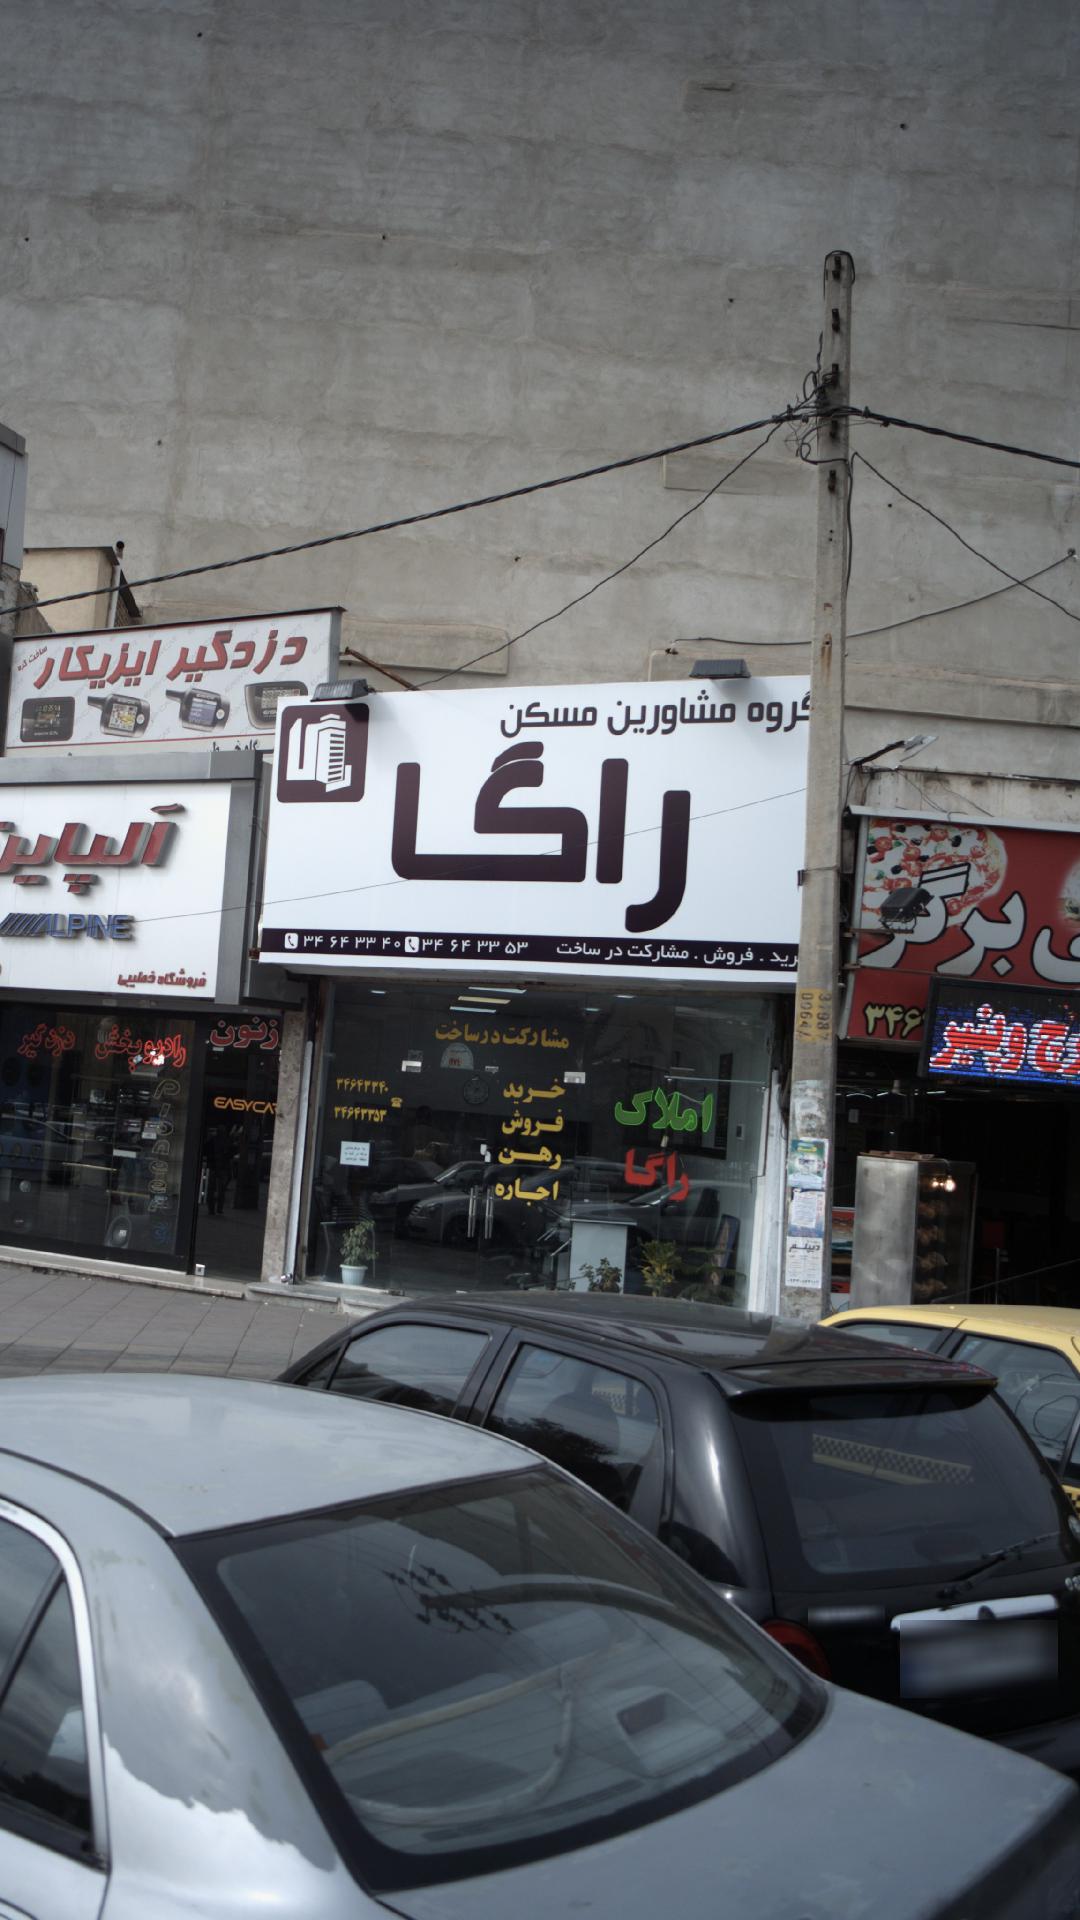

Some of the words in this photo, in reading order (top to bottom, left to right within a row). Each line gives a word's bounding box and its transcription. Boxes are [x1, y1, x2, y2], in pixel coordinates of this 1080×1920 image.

[33, 639, 162, 689] ایزیکار
[166, 630, 308, 682] دزدگیر
[500, 701, 598, 739] مسکن
[608, 689, 736, 736] مشاورین
[391, 741, 691, 932] راگا
[24, 913, 135, 940] ALPINE
[858, 862, 1028, 978] برگر
[303, 935, 324, 948] ۳۴
[330, 936, 350, 949] ۶۴
[355, 937, 377, 949] ۳۳
[382, 937, 401, 950] ۴۰
[422, 938, 443, 952] ۳۴
[450, 939, 471, 952] ۶۴
[477, 940, 500, 953] ۳۳
[505, 941, 528, 954] ۵۳
[556, 942, 601, 956] ساخت
[605, 945, 623, 960] در
[627, 943, 690, 963] مشارکت
[703, 946, 754, 965] فروش
[770, 951, 799, 967] رید
[157, 968, 207, 989] فروشگاه
[209, 1016, 279, 1050] زنون
[435, 1020, 479, 1042] ساخت
[480, 1026, 499, 1044] در
[502, 1025, 570, 1049] مشارکت
[503, 1078, 566, 1103] خرید
[502, 1109, 564, 1136] فروش
[614, 1087, 714, 1133] املاک
[498, 1145, 562, 1170] رهن
[624, 1148, 690, 1202] راگا
[495, 1178, 559, 1206] اجاره
